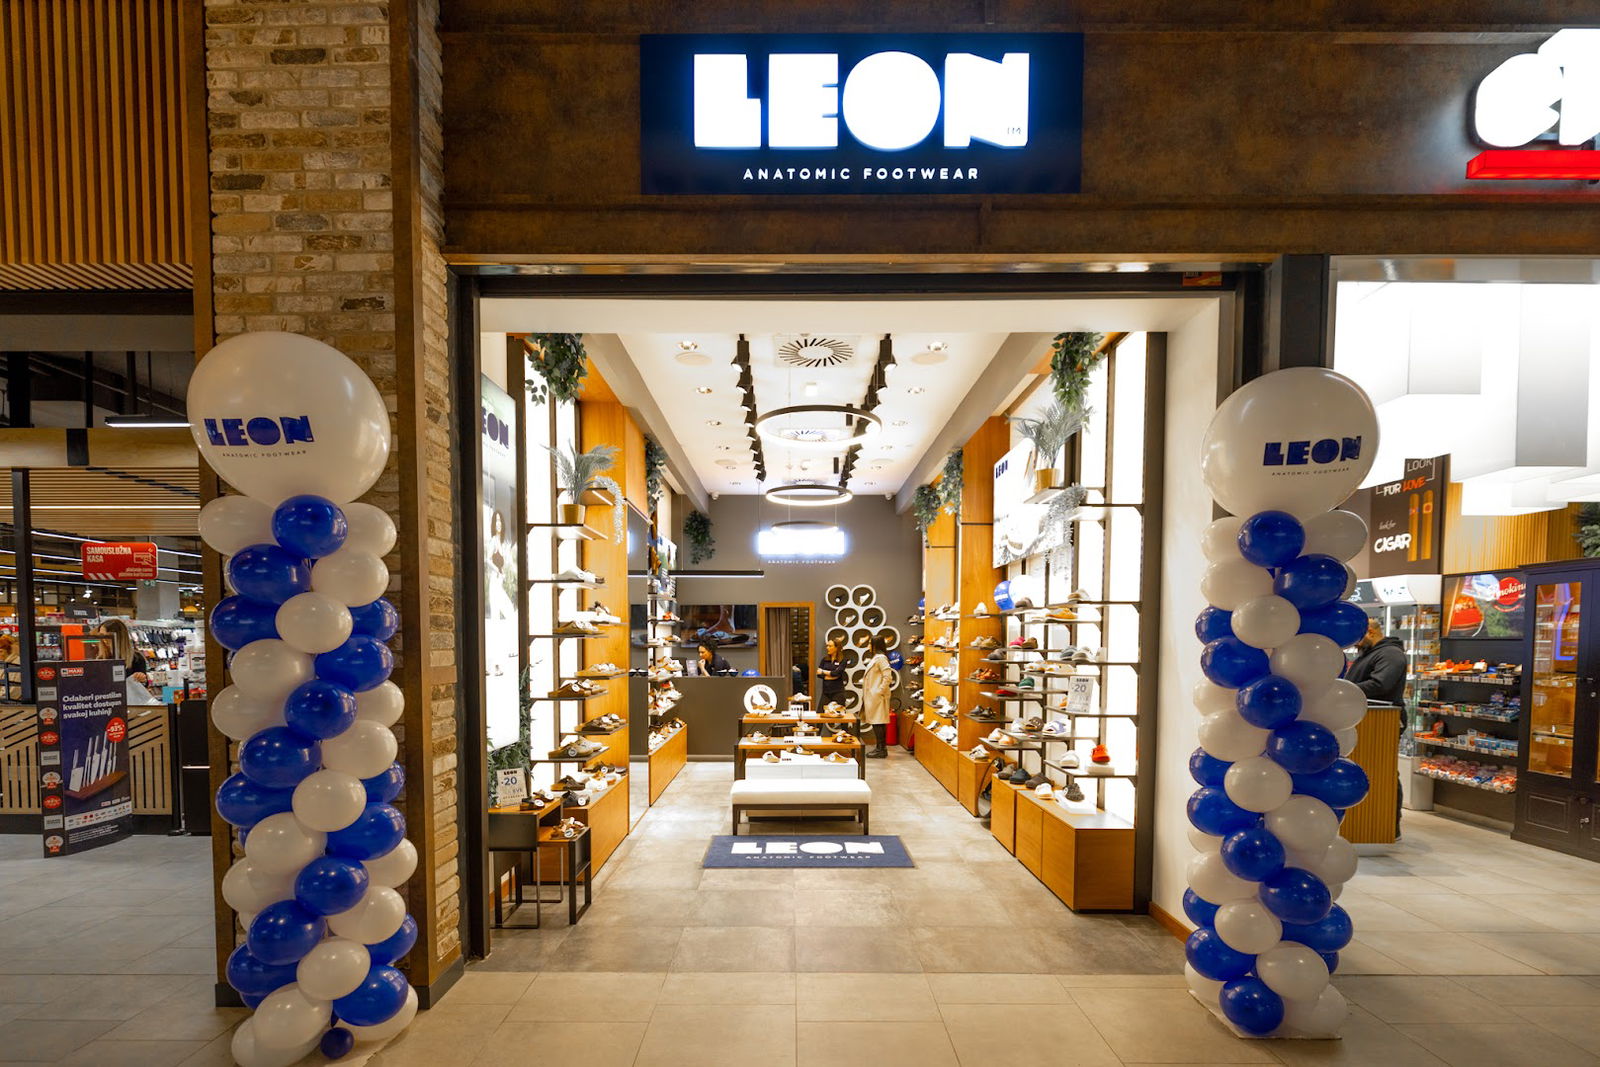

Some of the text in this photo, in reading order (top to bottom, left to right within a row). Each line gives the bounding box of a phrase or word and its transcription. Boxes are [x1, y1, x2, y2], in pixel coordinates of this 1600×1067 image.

[694, 51, 1029, 150] LEON
[743, 168, 978, 180] ANATOMIC FOOTWEAR
[204, 416, 315, 446] LEON
[1263, 435, 1362, 467] LEON
[1407, 458, 1433, 472] LOOK
[1403, 476, 1425, 493] LOVE
[1374, 533, 1412, 553] CIGAR
[86, 555, 104, 563] KASA
[62, 694, 94, 703] Odaberi
[63, 702, 92, 711] kvalitet
[63, 710, 88, 719] svakoj
[731, 842, 885, 854] LEON
